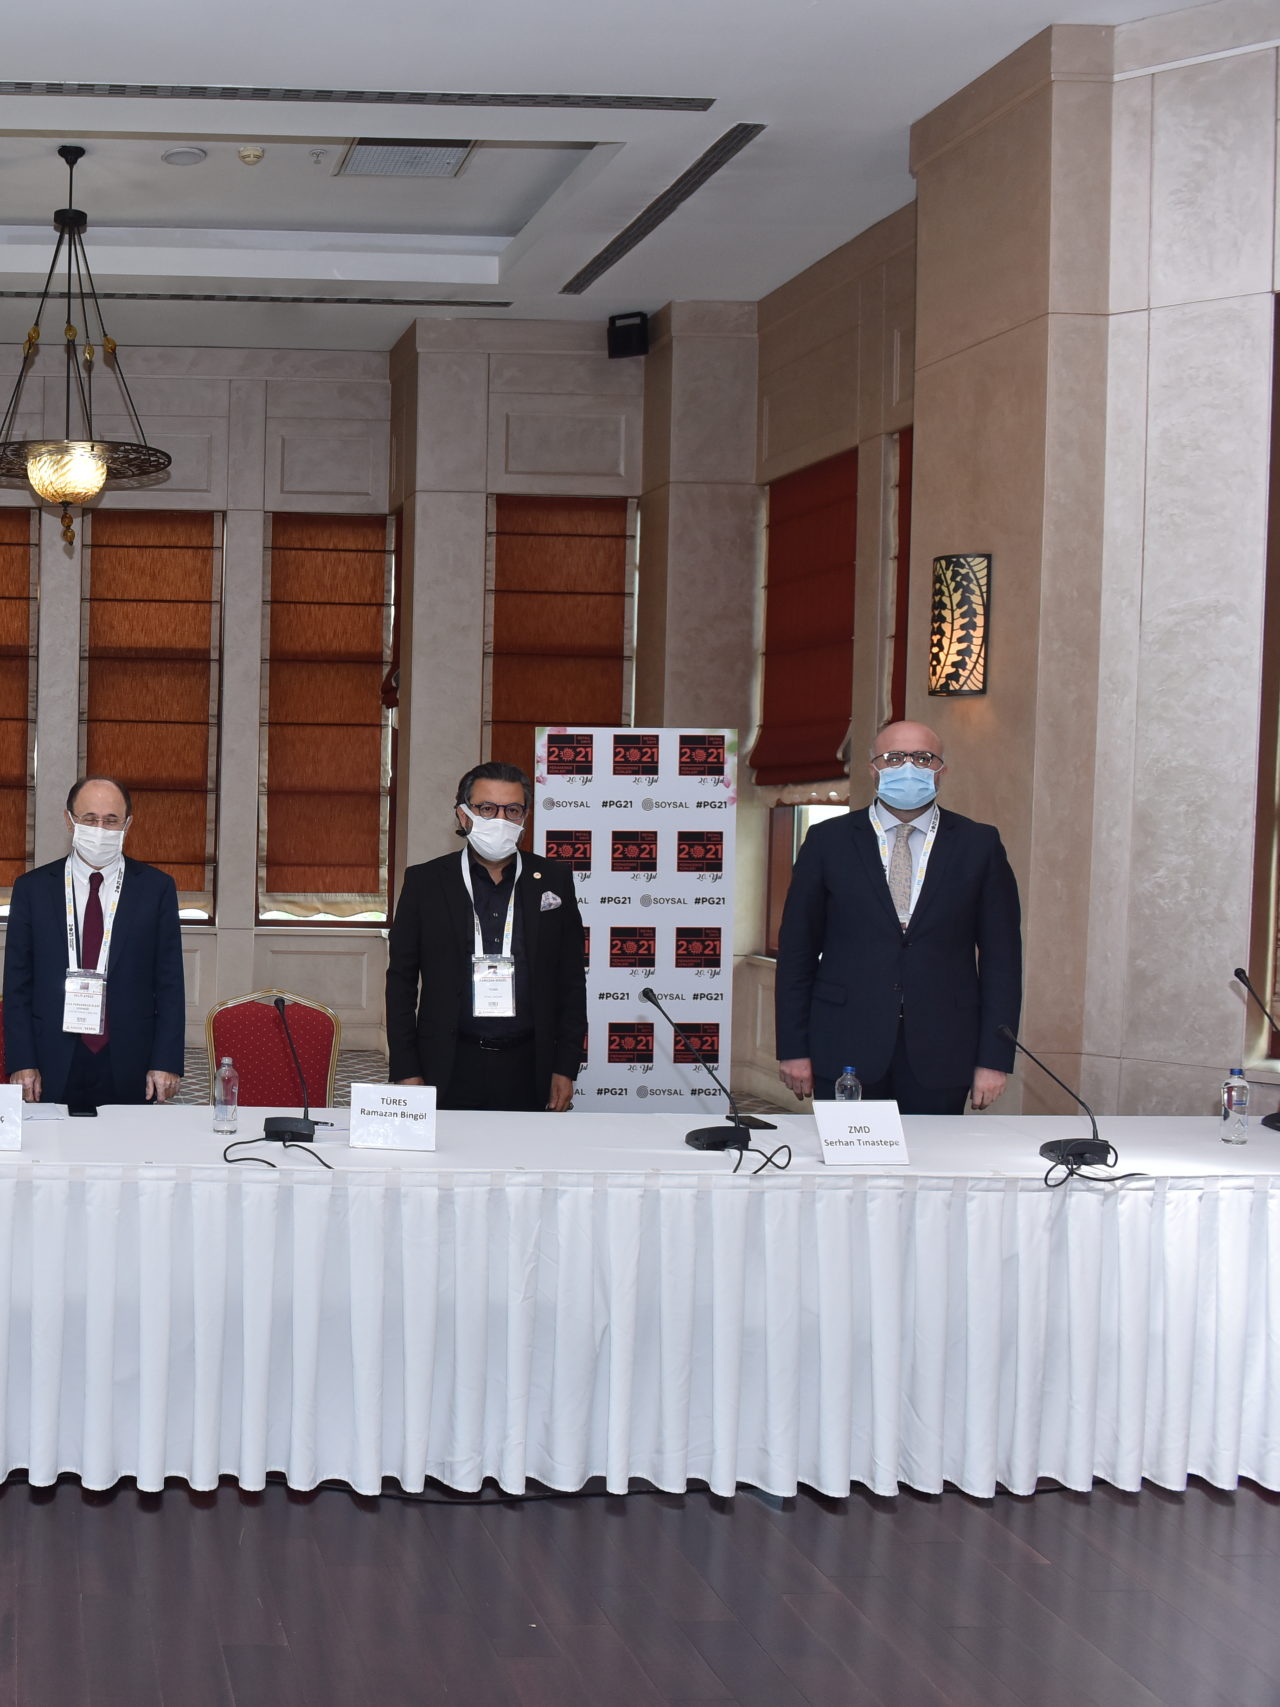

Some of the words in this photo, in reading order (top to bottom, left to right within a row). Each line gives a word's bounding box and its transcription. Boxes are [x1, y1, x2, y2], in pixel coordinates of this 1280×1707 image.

[555, 800, 590, 808] SOYSAL
[602, 800, 633, 808] #PG21
[696, 801, 727, 809] #PG21
[600, 896, 631, 905] #PG21
[653, 897, 688, 905] SOYSAL
[694, 897, 726, 905] #PG21
[598, 992, 630, 1001] #PG21
[692, 993, 724, 1001] #PG21
[596, 1088, 628, 1096] #PG21
[690, 1088, 721, 1096] #PG21
[381, 1096, 408, 1106] TÜRES
[360, 1108, 398, 1117] Ramazan
[400, 1111, 427, 1121] Bingöl
[848, 1126, 871, 1134] ZMD
[824, 1139, 854, 1147] Serhan
[857, 1139, 900, 1147] Tınastepe
